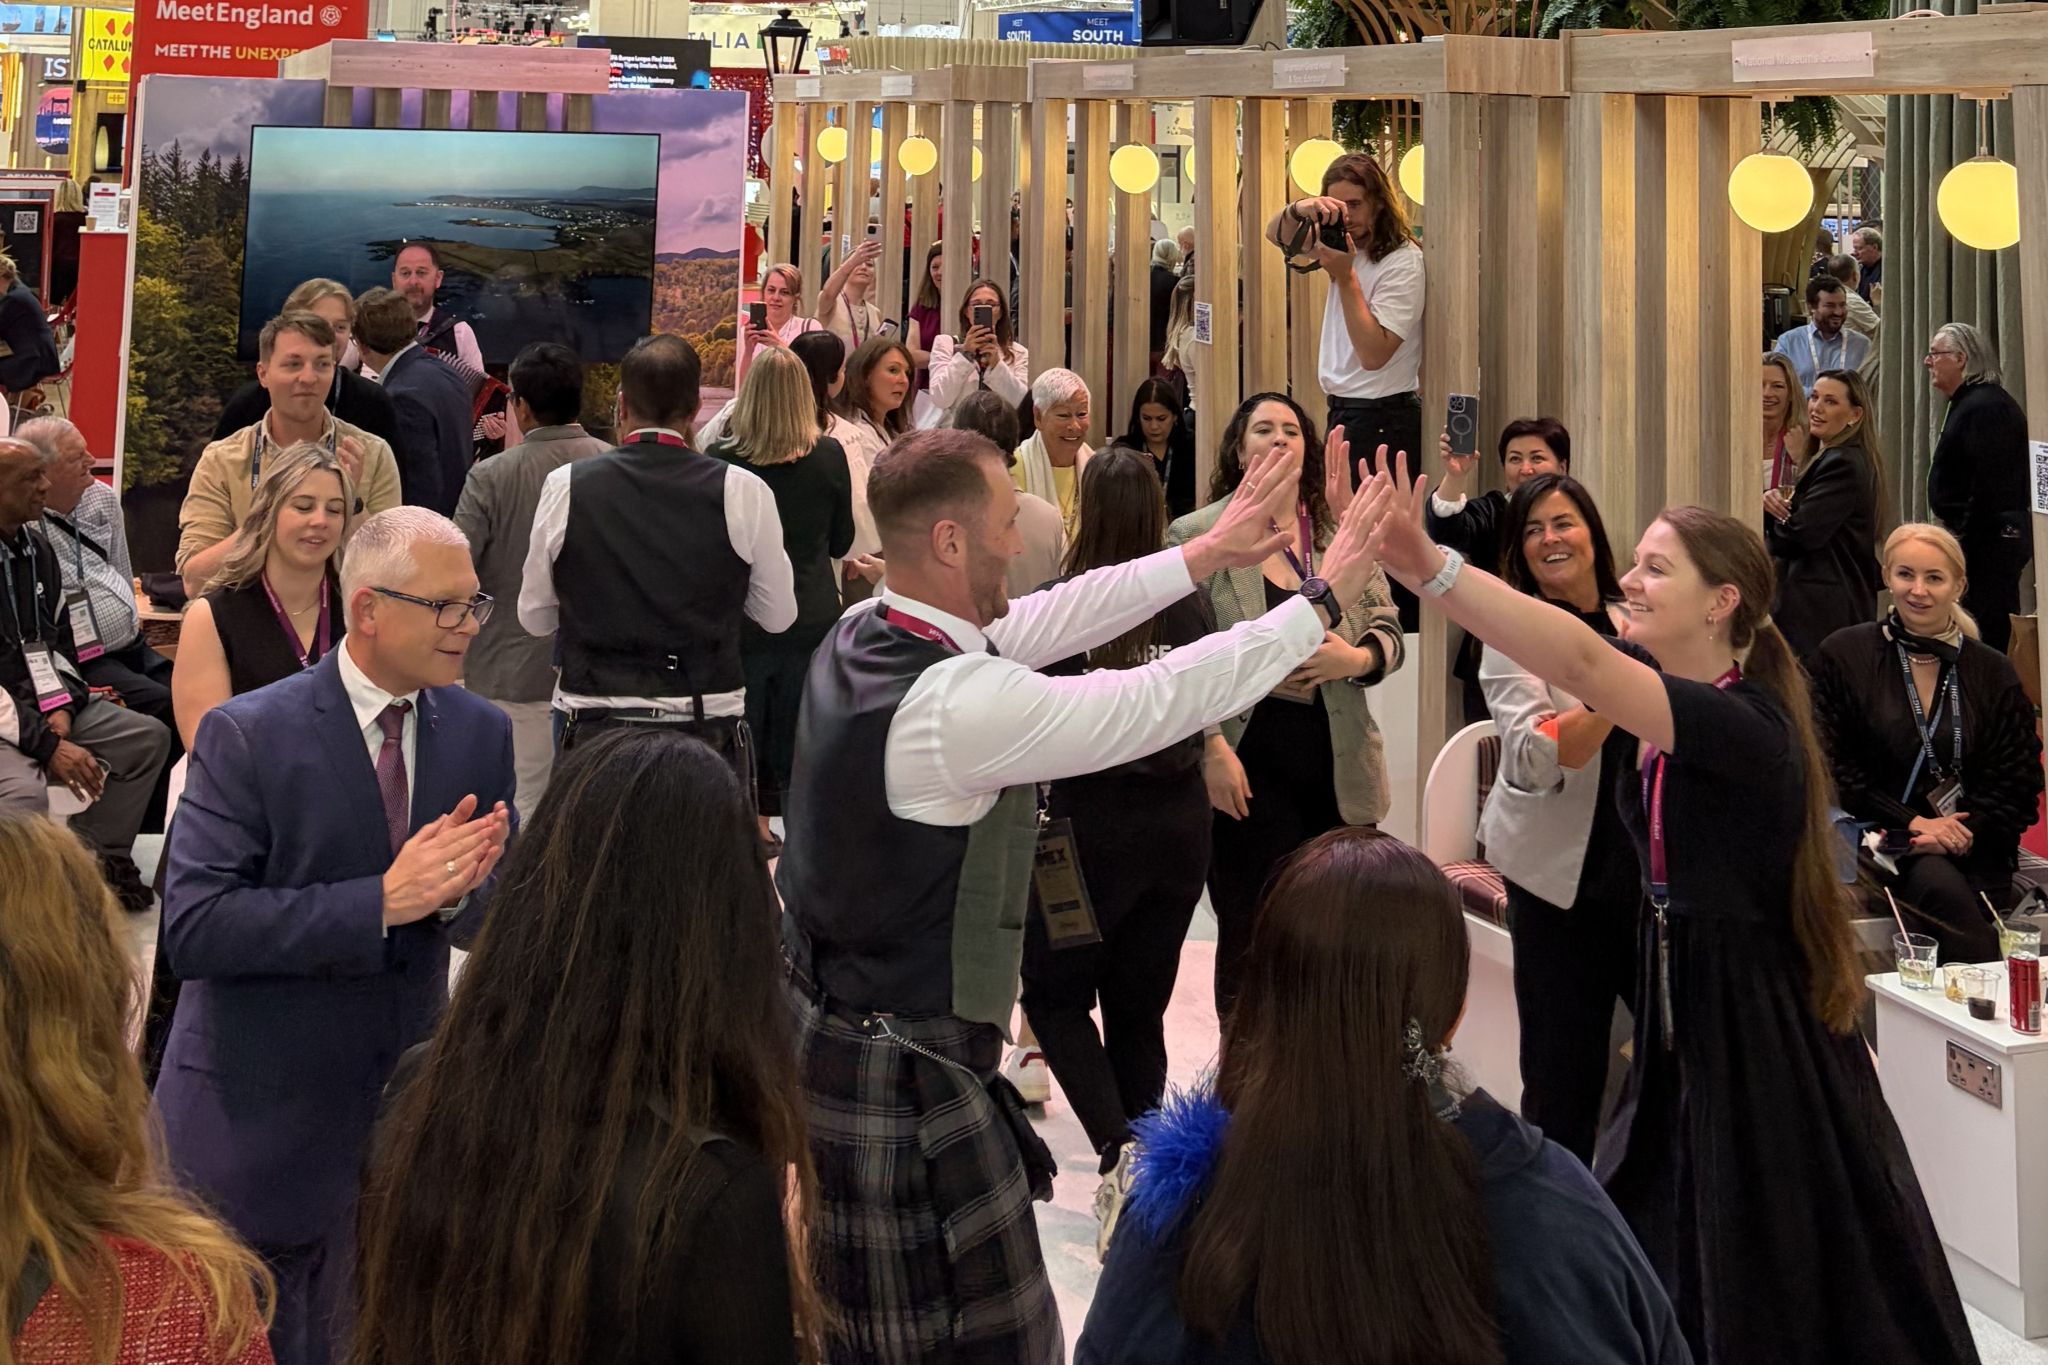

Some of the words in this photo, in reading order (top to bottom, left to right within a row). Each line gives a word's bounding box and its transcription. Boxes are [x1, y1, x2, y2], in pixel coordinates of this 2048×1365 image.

[1087, 18, 1109, 26] MEET
[1007, 31, 1031, 41] SOUTH
[1073, 30, 1123, 42] SOUTH
[155, 44, 199, 57] MEET
[200, 45, 231, 59] THE
[44, 58, 70, 77] IS
[1953, 727, 1962, 743] IHG
